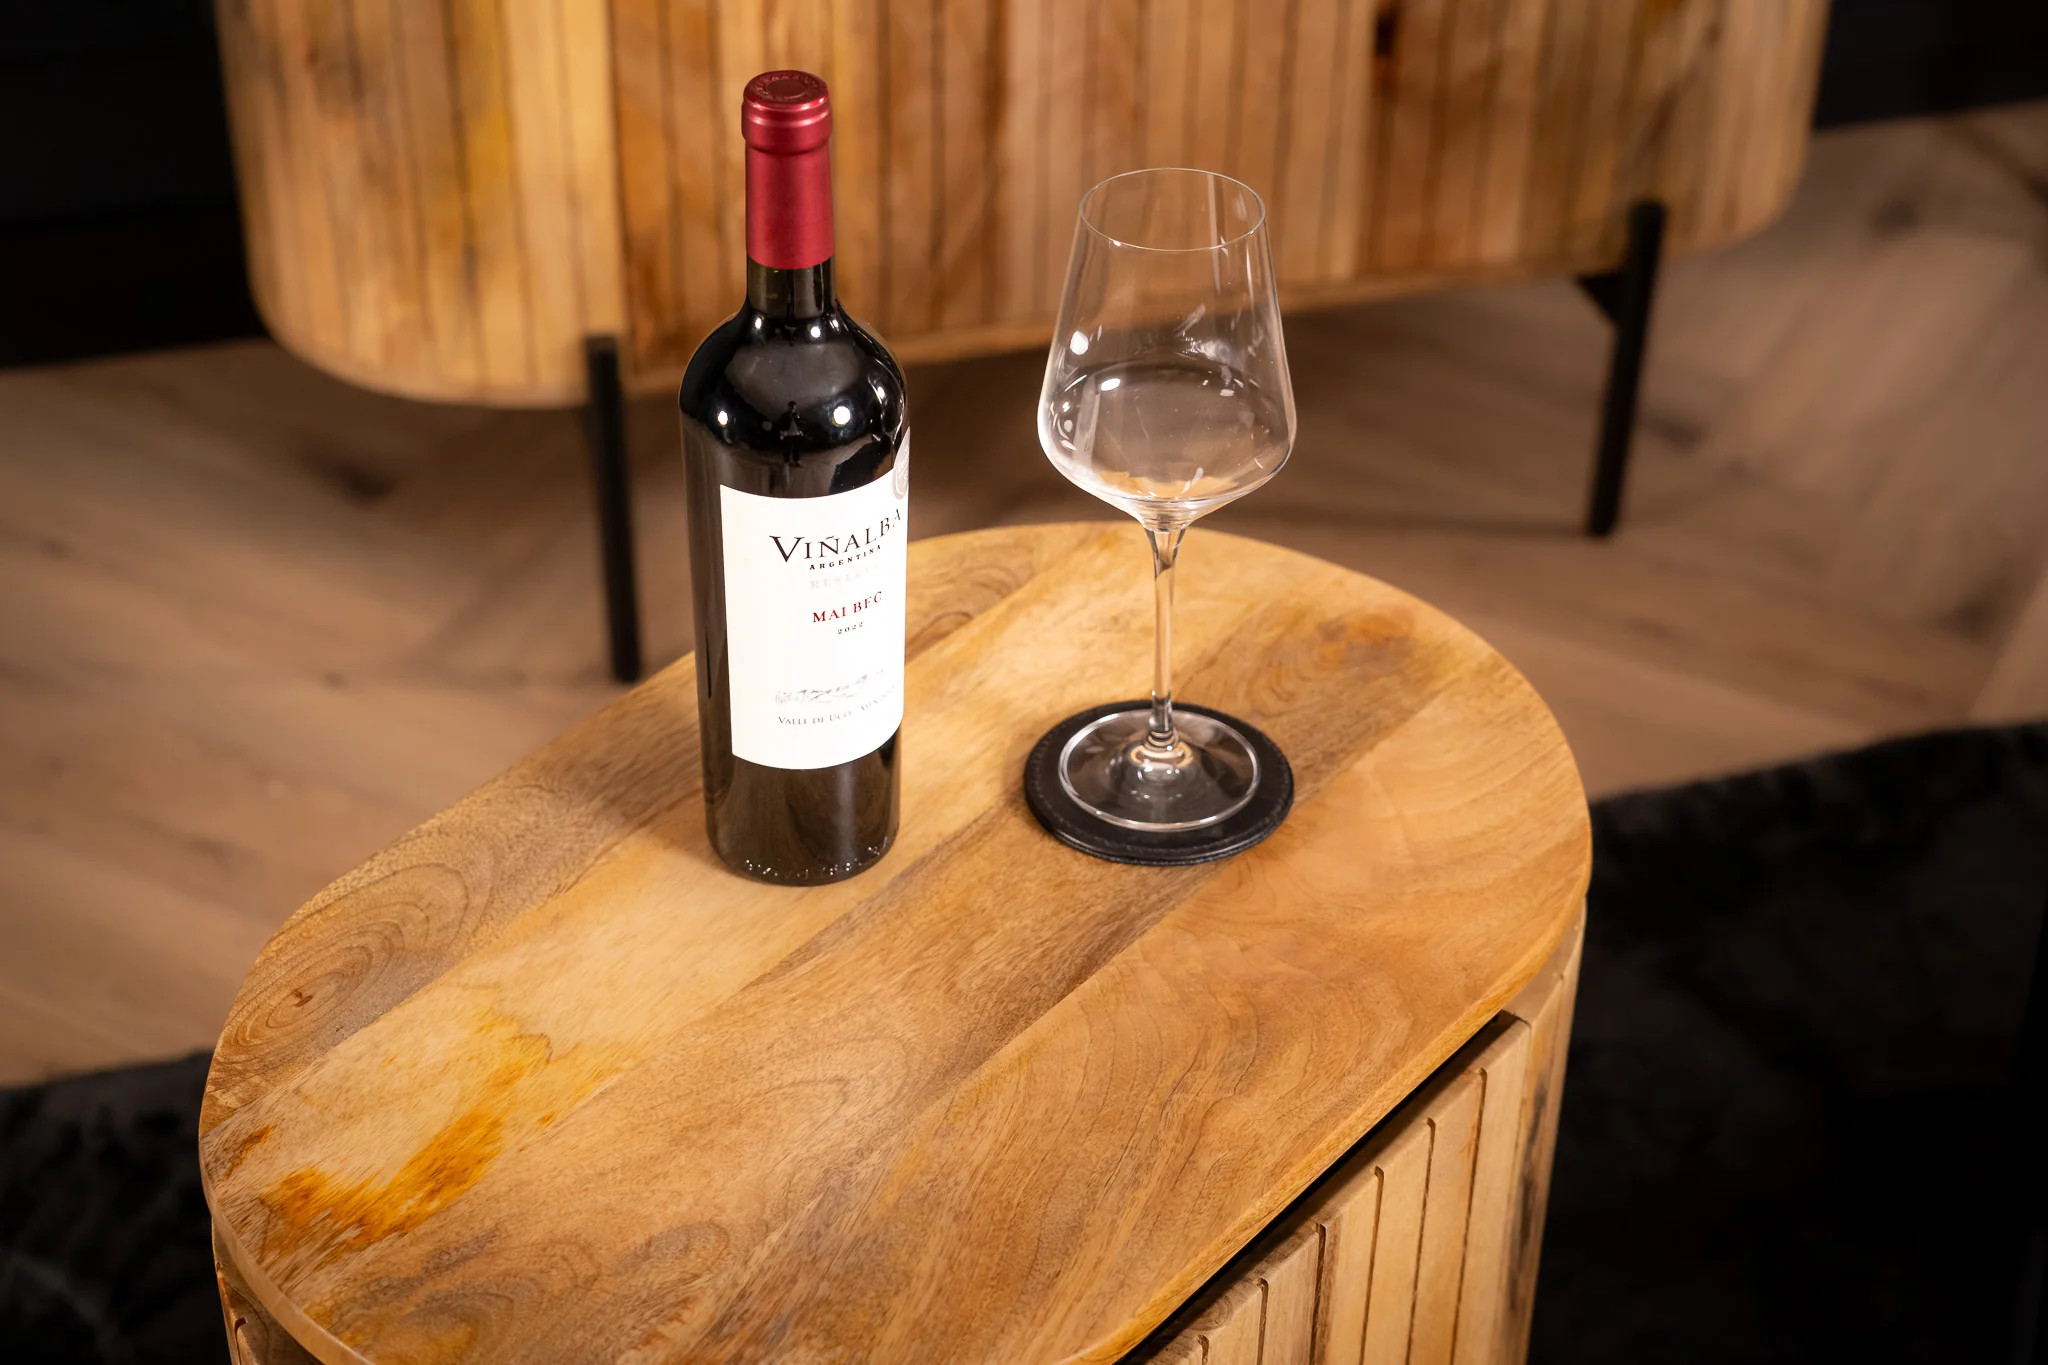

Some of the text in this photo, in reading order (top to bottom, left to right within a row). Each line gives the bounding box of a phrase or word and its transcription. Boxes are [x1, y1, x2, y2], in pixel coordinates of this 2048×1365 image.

[769, 508, 901, 562] VIÑALBA
[810, 544, 881, 570] ARGENTINA
[812, 590, 883, 623] MALBEC
[837, 621, 864, 635] 2022
